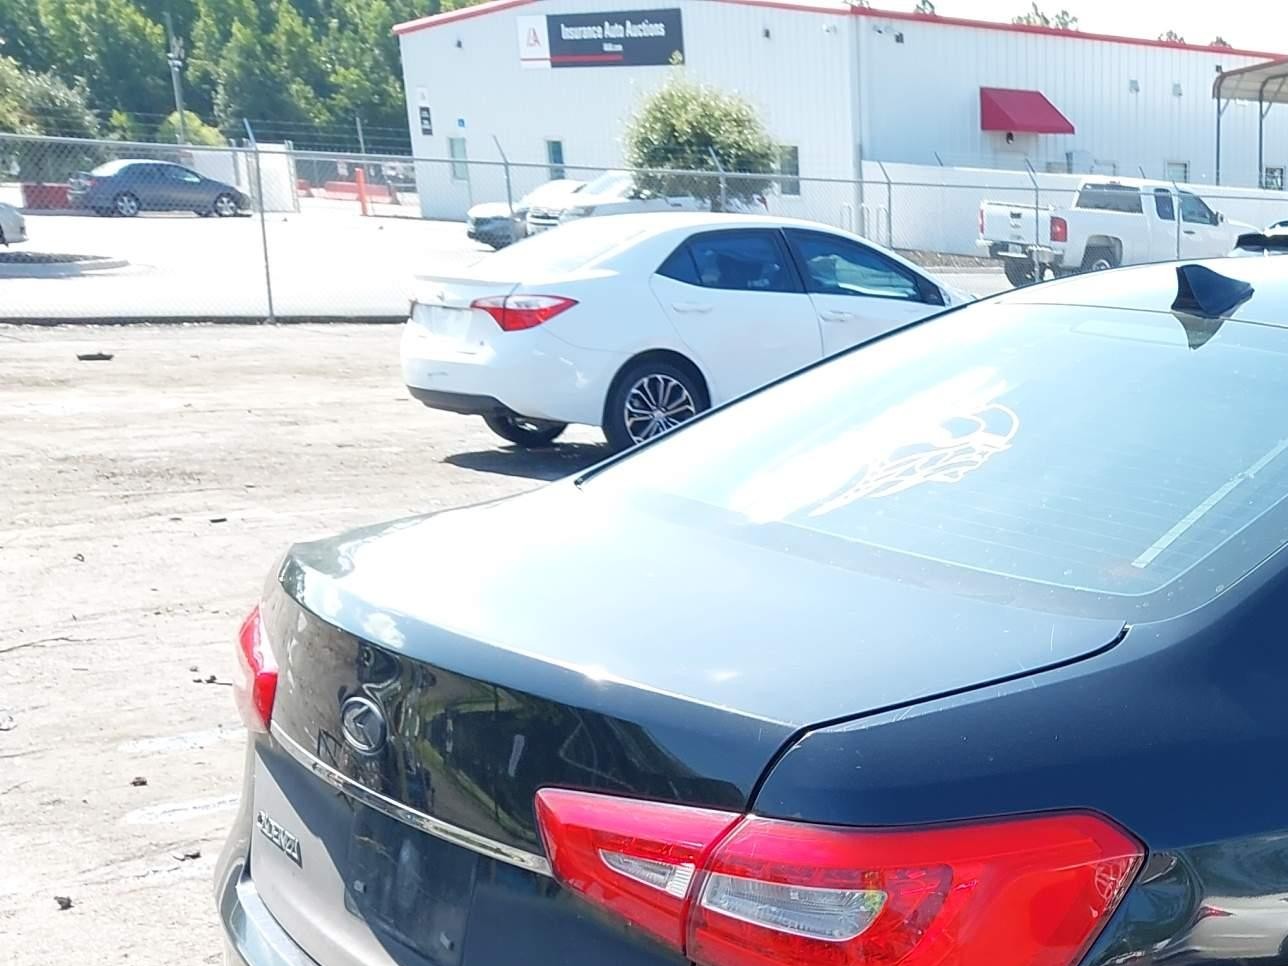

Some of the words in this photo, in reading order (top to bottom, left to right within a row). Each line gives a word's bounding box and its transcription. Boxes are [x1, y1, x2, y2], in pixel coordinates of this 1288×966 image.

[560, 23, 603, 40] Insurance
[604, 20, 625, 39] Auto
[625, 19, 666, 38] Auctions
